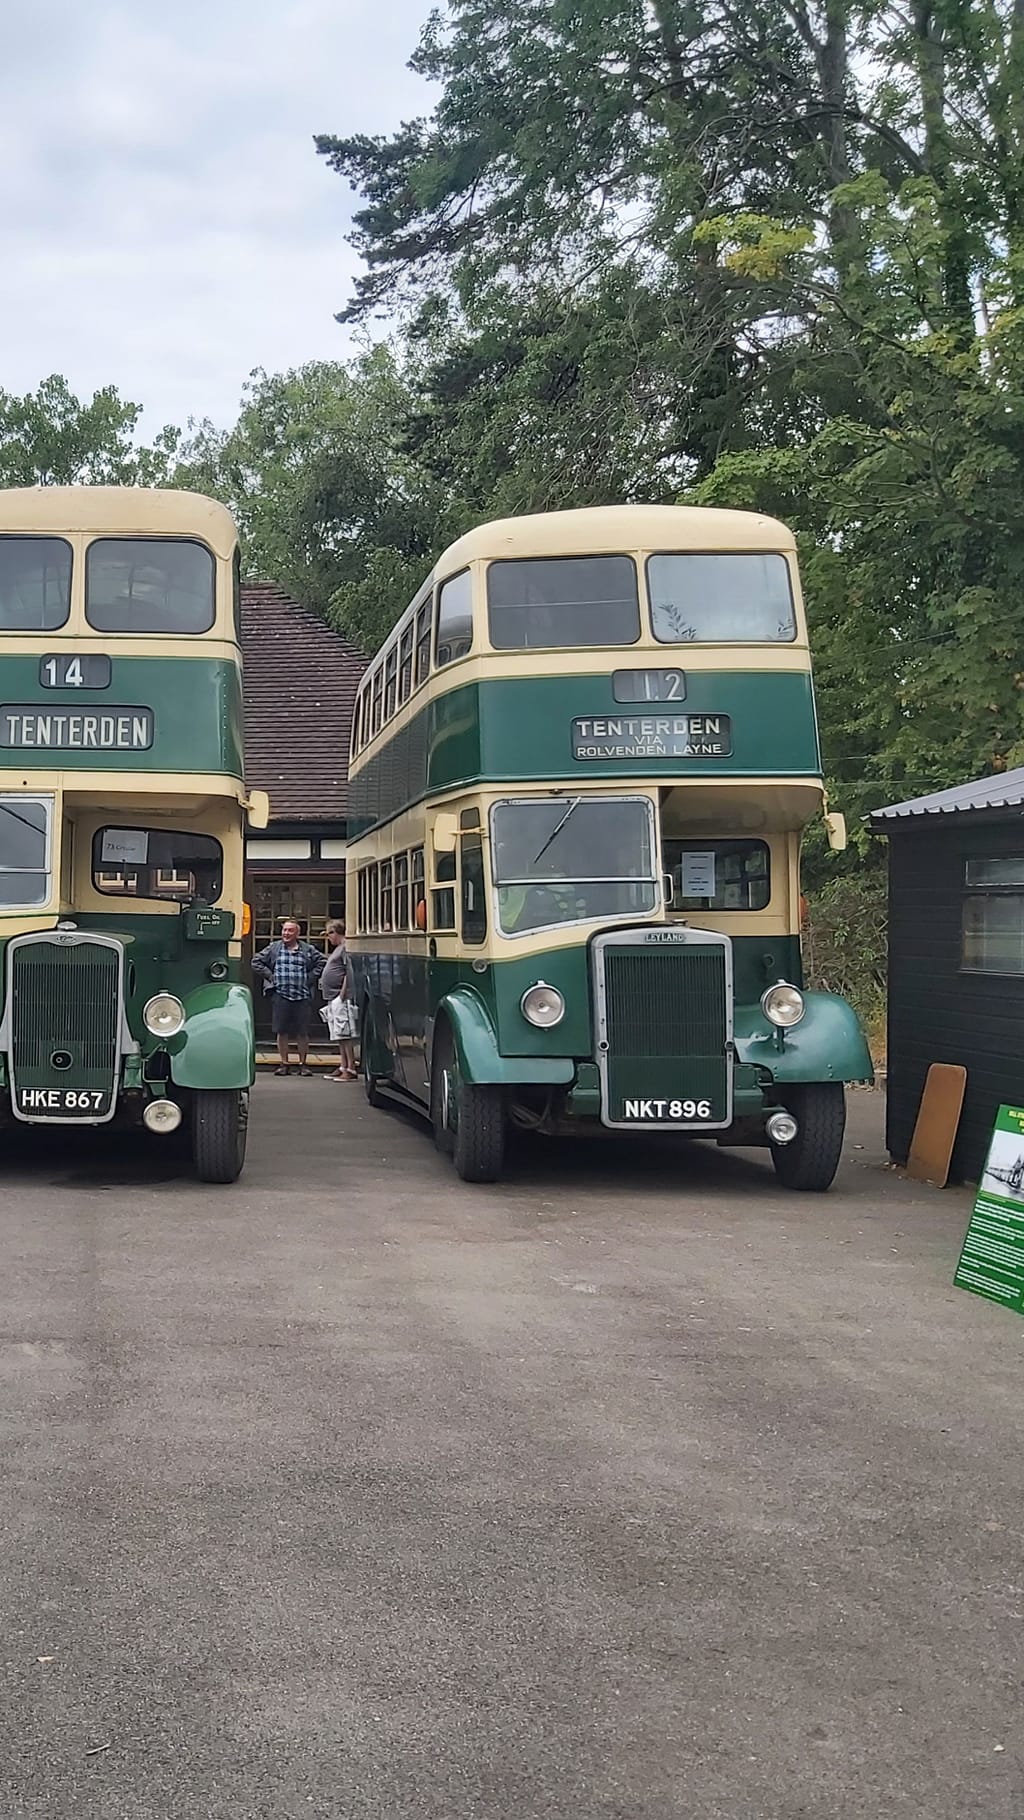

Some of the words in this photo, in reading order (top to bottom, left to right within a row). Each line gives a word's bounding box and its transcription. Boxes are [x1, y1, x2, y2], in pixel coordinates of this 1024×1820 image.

[45, 658, 84, 687] 14
[6, 715, 147, 746] TENTERDEN
[576, 718, 720, 737] TENTERDEN
[634, 736, 663, 745] VIA
[577, 745, 667, 757] ROLVENDEN
[673, 743, 723, 755] LAYNE
[646, 932, 684, 942] LEYLAND
[22, 1089, 61, 1108] HKE
[64, 1091, 104, 1109] 867
[625, 1100, 667, 1118] NKT
[669, 1100, 711, 1118] 896
